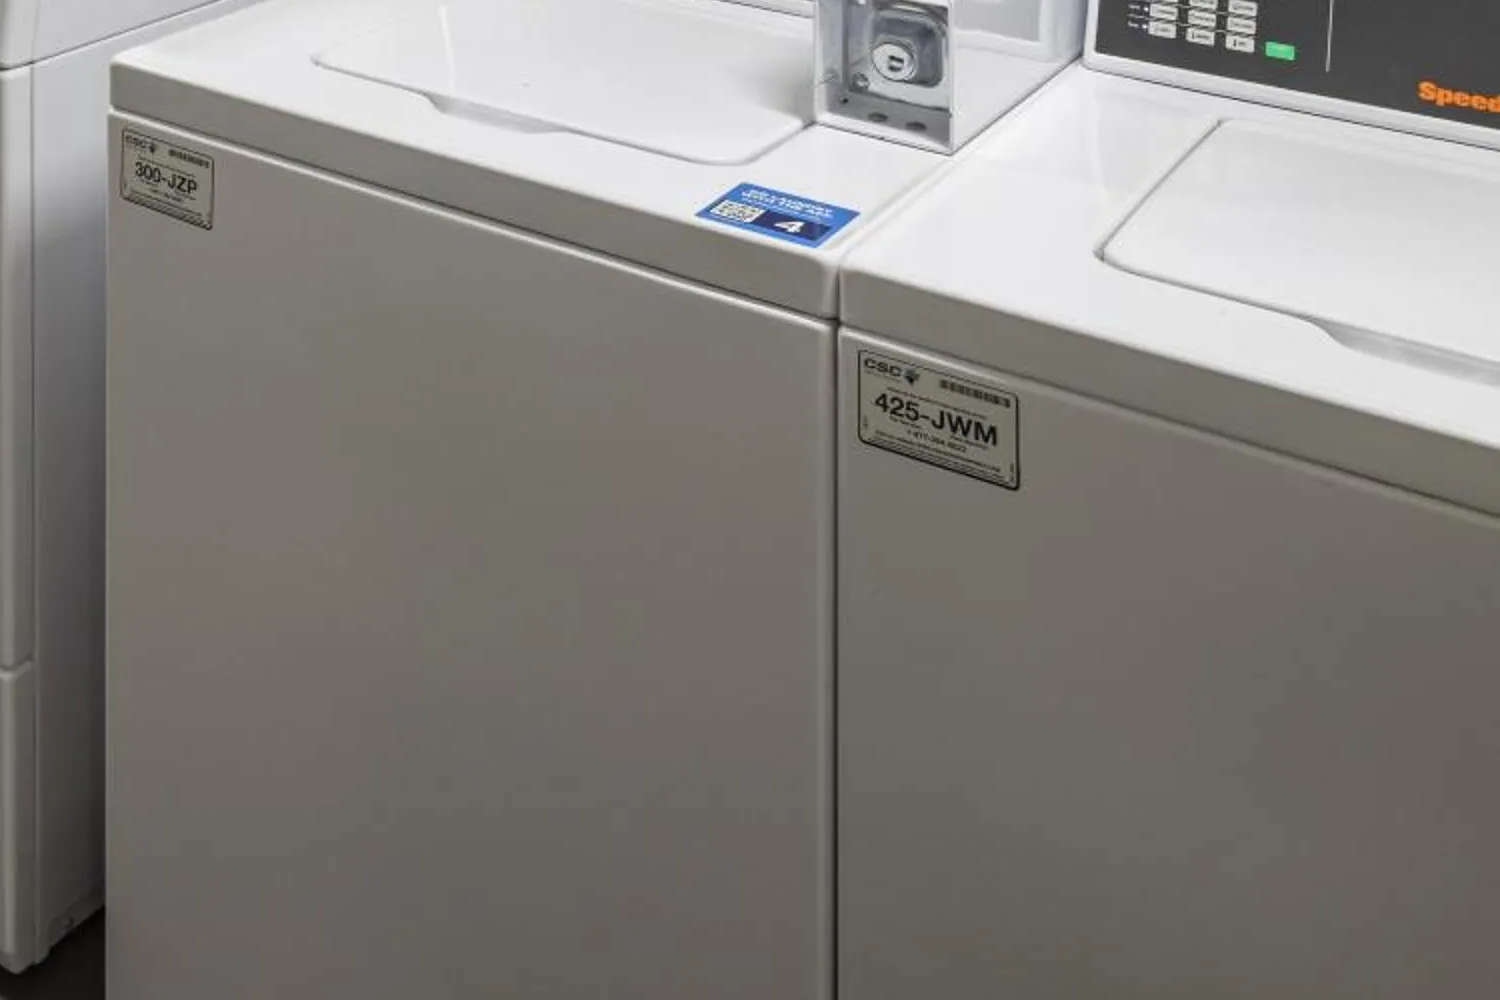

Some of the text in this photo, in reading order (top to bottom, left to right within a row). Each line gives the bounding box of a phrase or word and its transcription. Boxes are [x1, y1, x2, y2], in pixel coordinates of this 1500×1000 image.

[135, 161, 197, 194] 300-JZP
[773, 220, 805, 233] 4
[863, 357, 902, 377] CSC
[875, 392, 998, 447] 425-JWM
